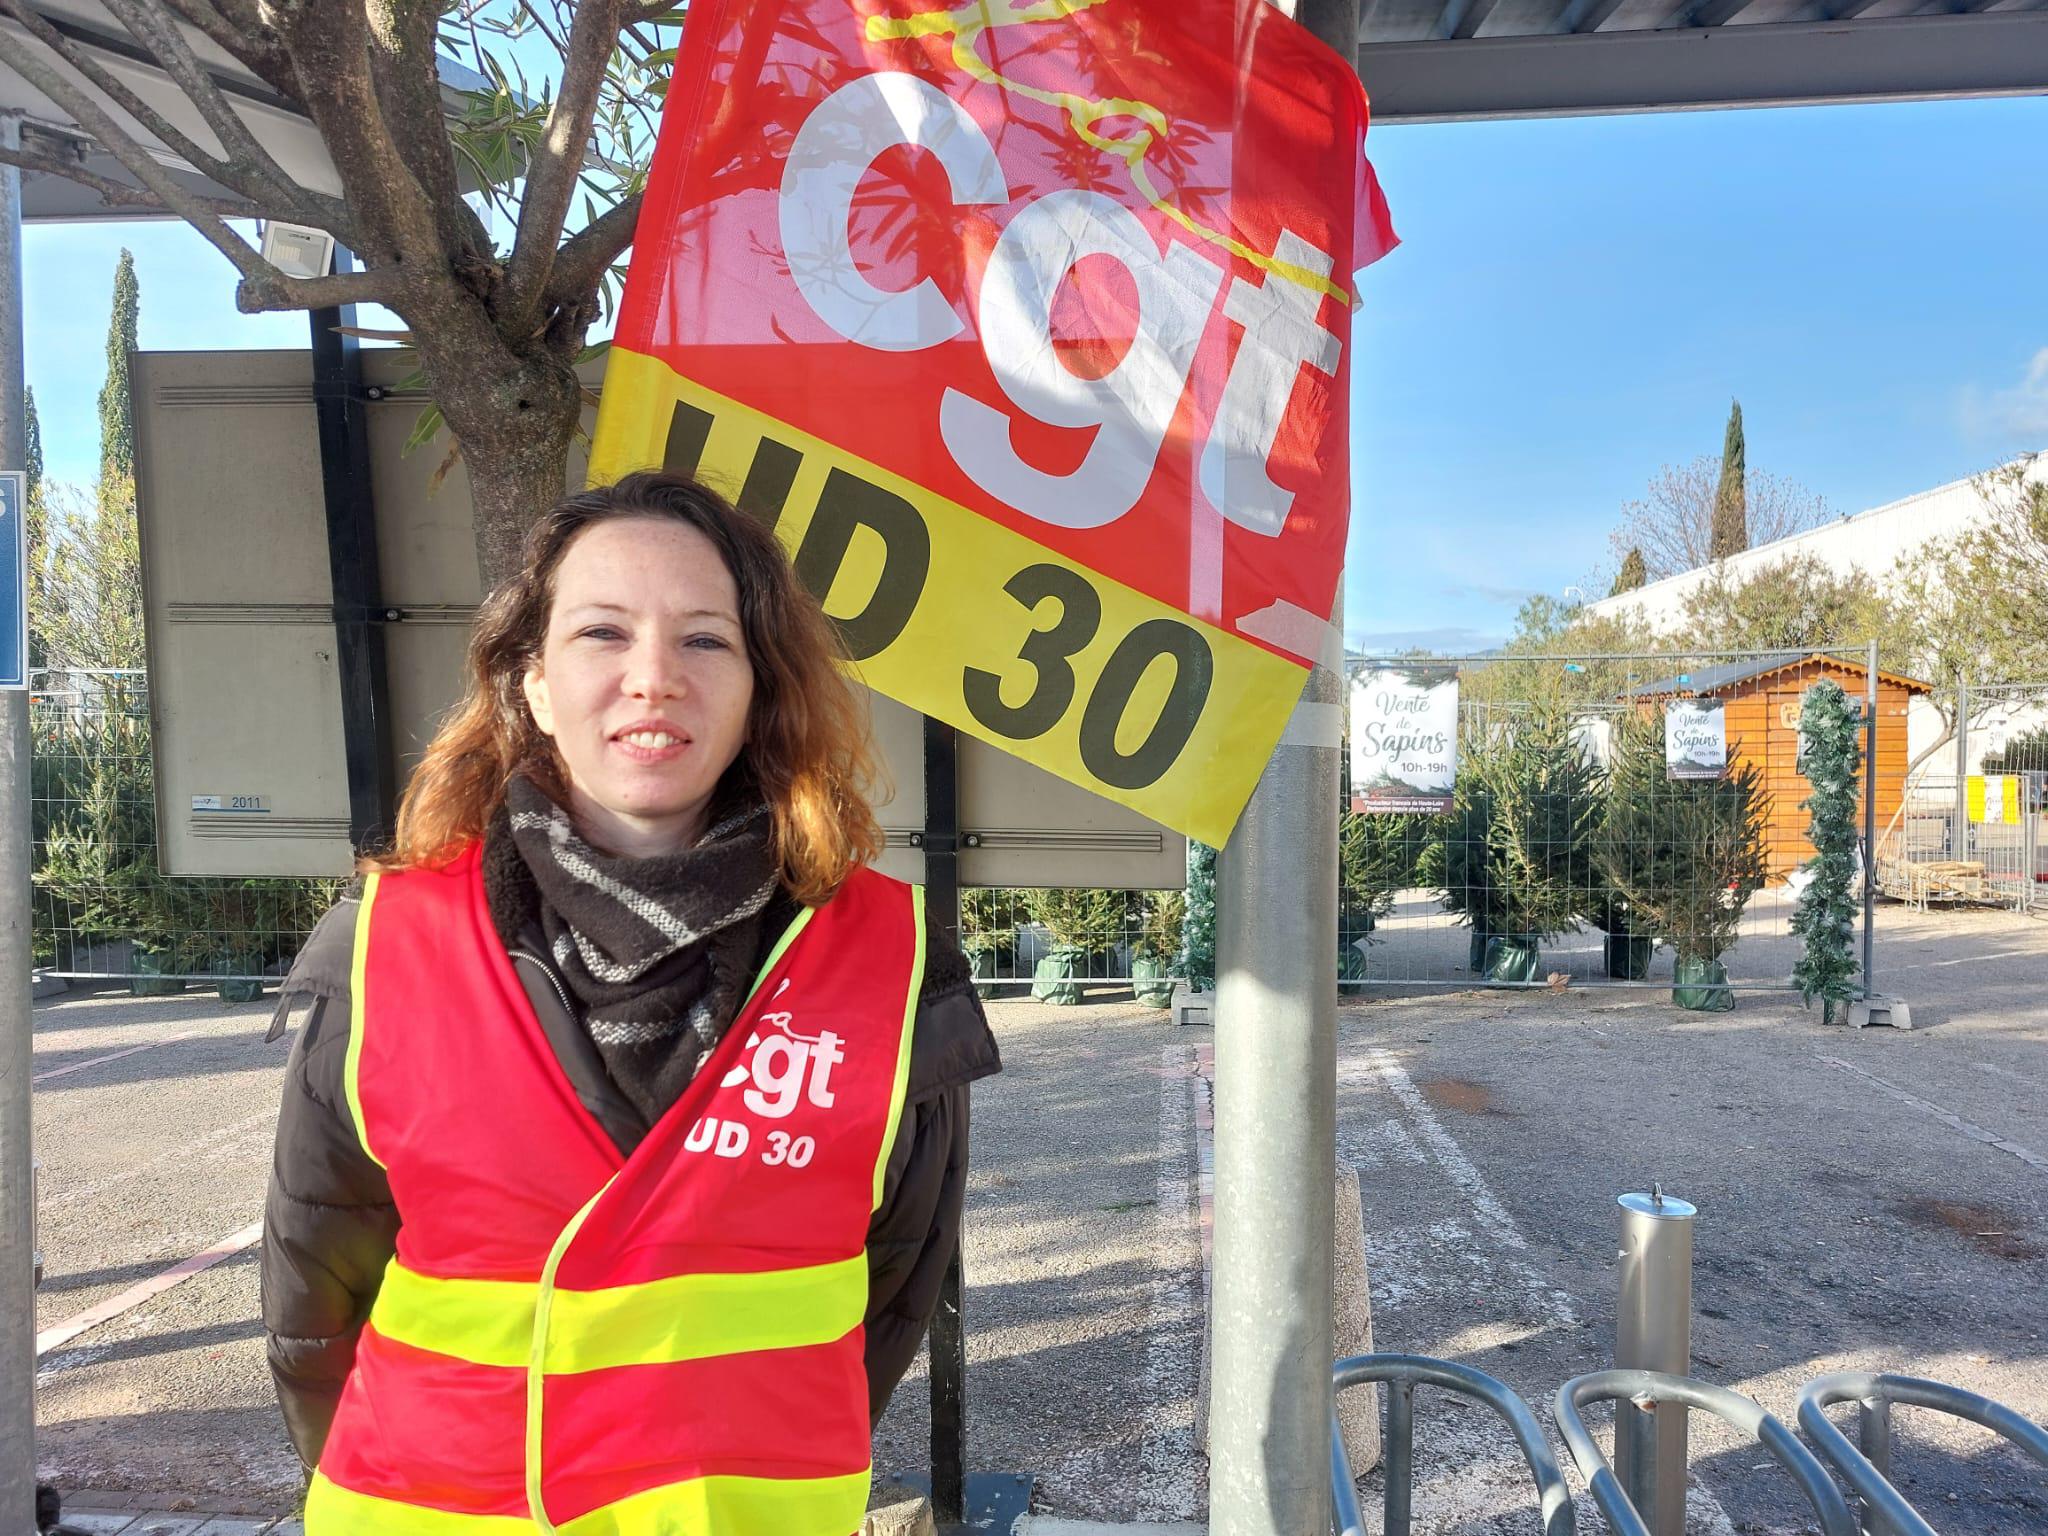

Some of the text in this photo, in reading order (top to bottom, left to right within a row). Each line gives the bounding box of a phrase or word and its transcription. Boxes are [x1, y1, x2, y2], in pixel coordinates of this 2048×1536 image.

[778, 71, 1341, 537] cgt
[962, 563, 1213, 790] 30
[1376, 691, 1430, 716] Vente
[1396, 717, 1411, 729] de
[1680, 713, 1710, 727] Vente
[1362, 722, 1448, 762] Sapins
[1673, 730, 1719, 752] Sapins
[1402, 763, 1447, 773] 10h-19h
[232, 797, 260, 808] 2011
[684, 1117, 816, 1169] UD 30
